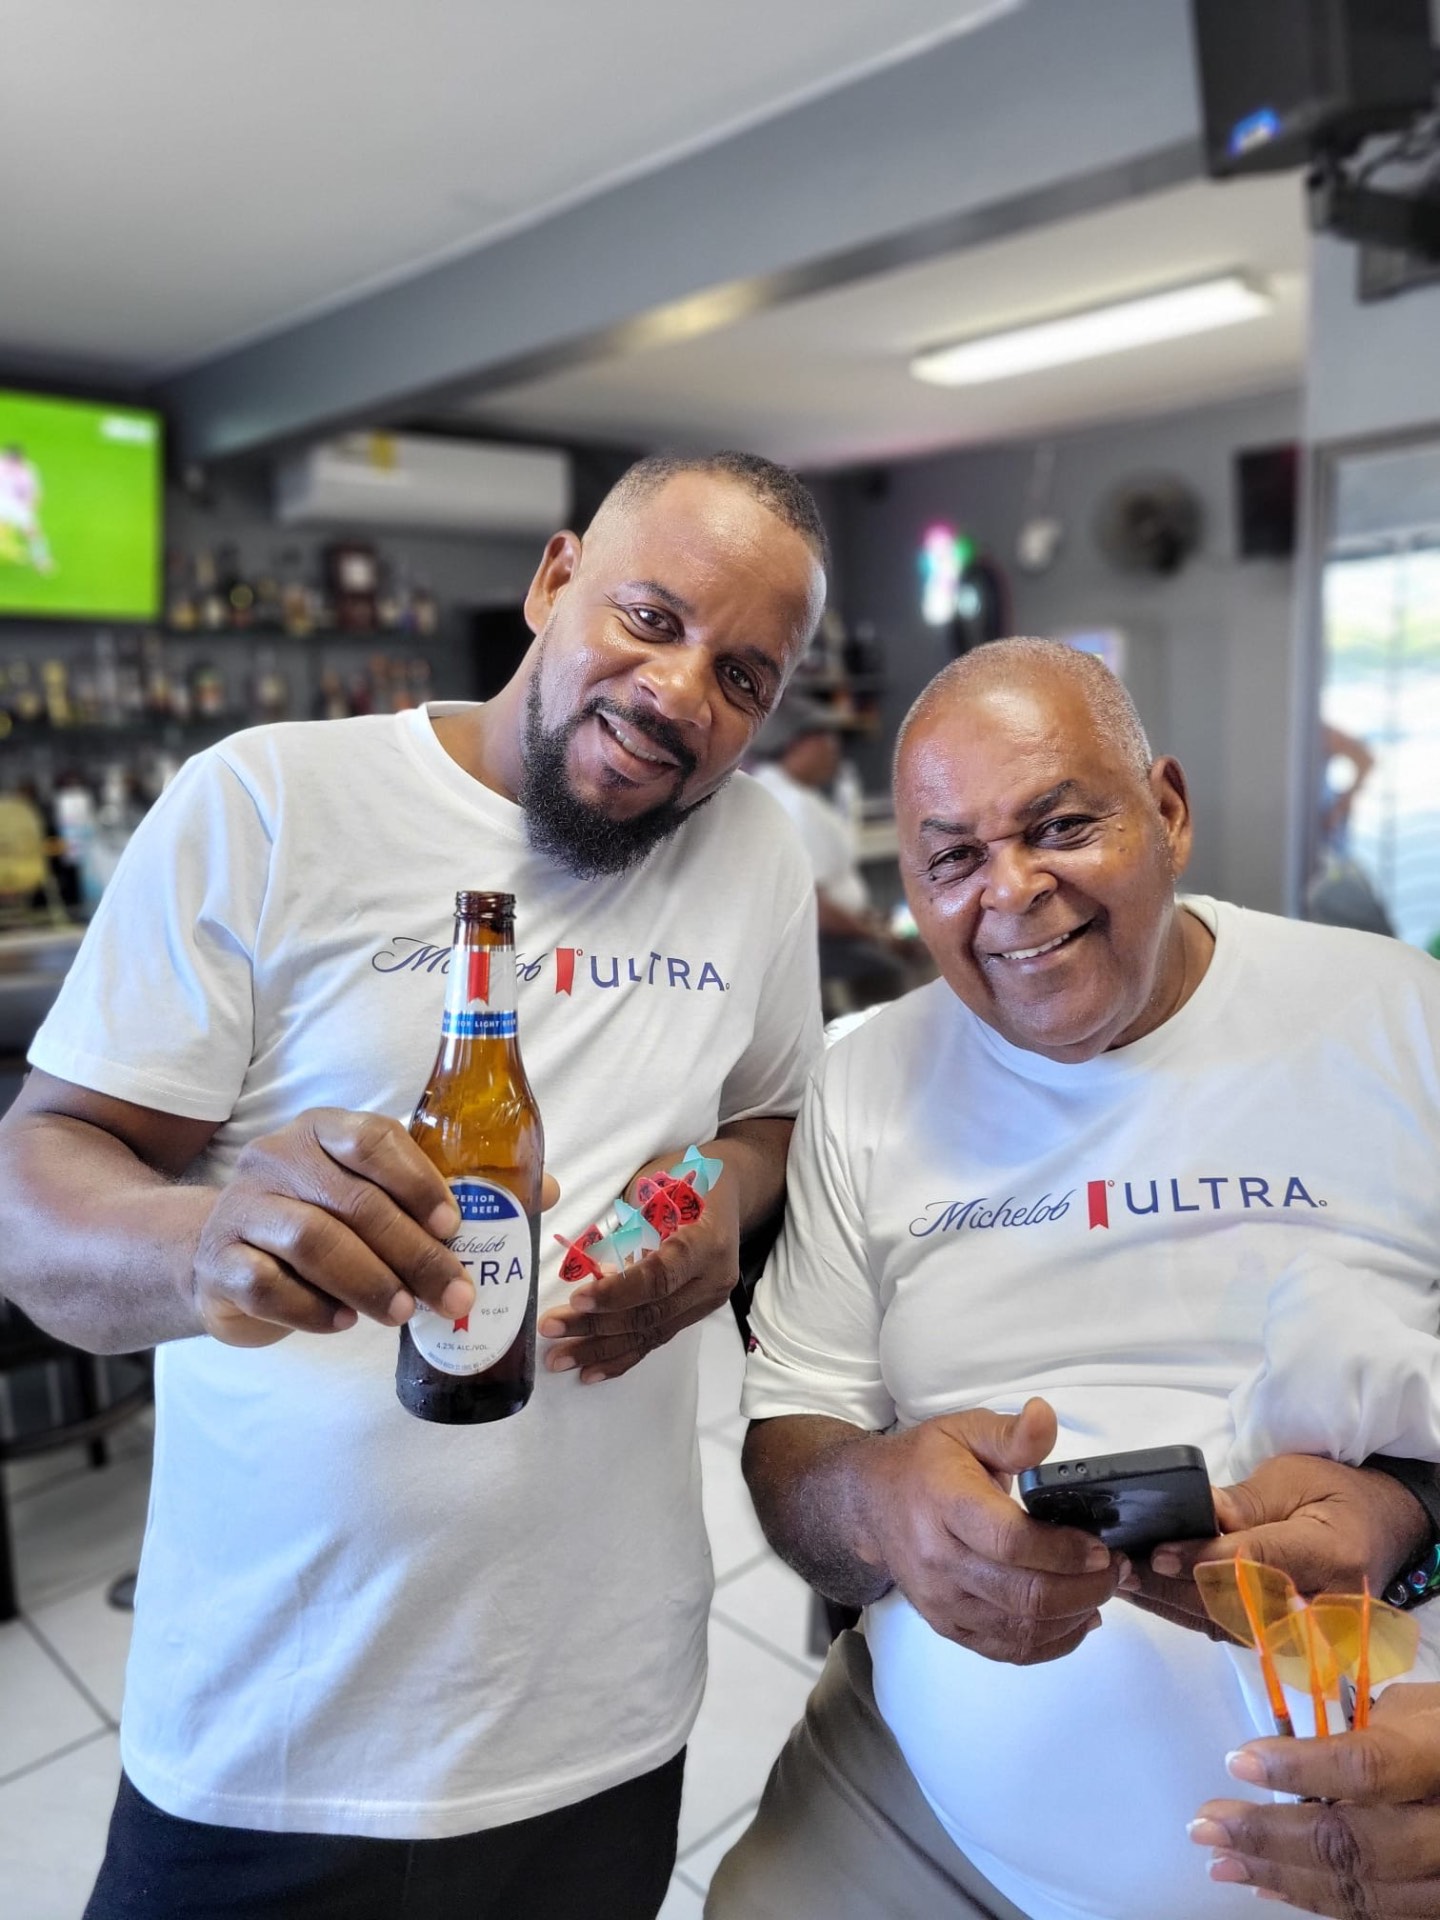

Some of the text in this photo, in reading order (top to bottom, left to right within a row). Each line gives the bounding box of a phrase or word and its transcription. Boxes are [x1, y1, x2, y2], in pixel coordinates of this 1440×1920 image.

[590, 951, 725, 992] ULTRA
[474, 1020, 500, 1028] LIGHT
[454, 1194, 495, 1203] PERIOR
[472, 1205, 500, 1214] BEER
[908, 1176, 1319, 1238] Michelob ULTRA
